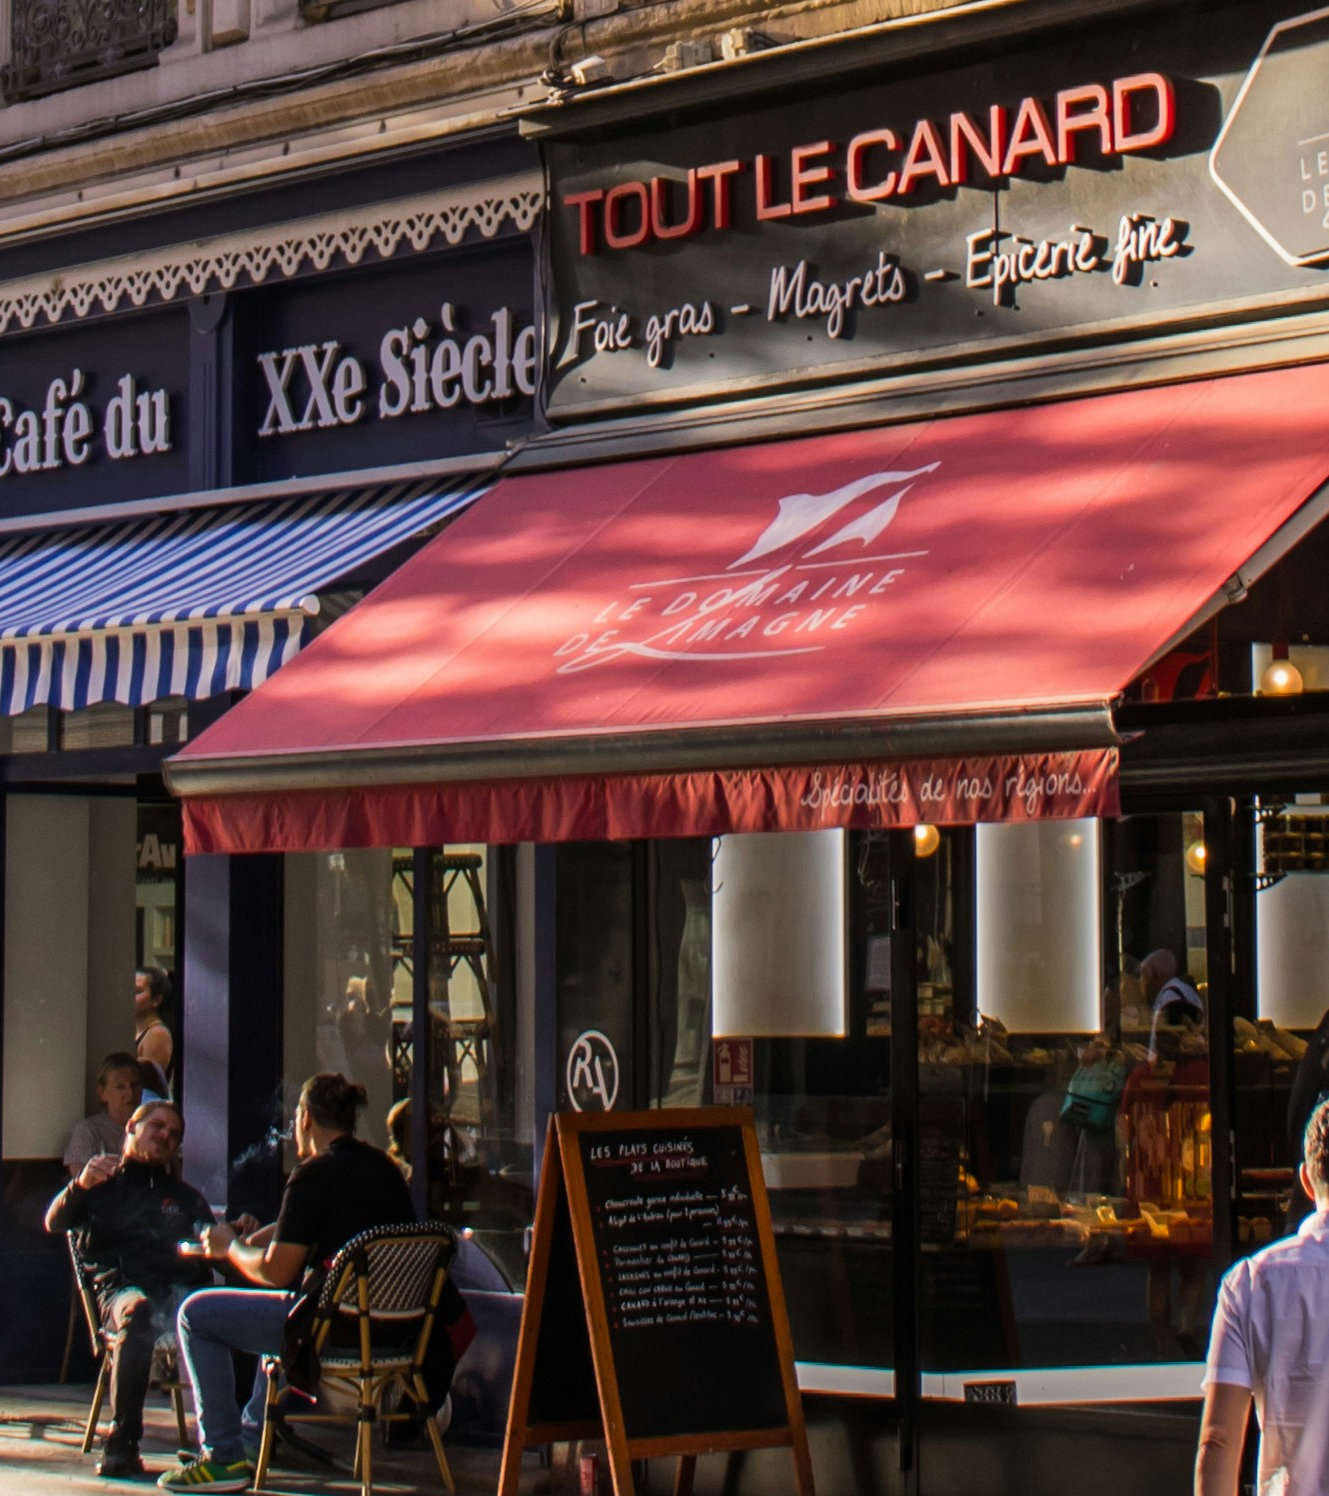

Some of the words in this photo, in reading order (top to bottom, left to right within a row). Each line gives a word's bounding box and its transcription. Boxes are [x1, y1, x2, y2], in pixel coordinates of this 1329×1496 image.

[563, 159, 744, 256] TOUT
[755, 140, 836, 221] LE
[847, 72, 1177, 202] CANARD
[1300, 150, 1329, 180] LE
[572, 299, 633, 359] Foie
[646, 300, 716, 368] gras
[767, 259, 907, 339] Magrets
[966, 225, 1099, 306] Epicerie
[1112, 212, 1181, 285] fine
[257, 340, 367, 437] XXe
[379, 302, 536, 419] Siècle
[103, 372, 173, 459] du
[592, 597, 652, 624] LE
[661, 568, 906, 617] DOMAINE
[553, 628, 620, 657] DE
[800, 769, 908, 822] Spécialités
[919, 771, 946, 803] de
[956, 774, 993, 800] nos
[590, 1145, 611, 1160] LES
[619, 1143, 647, 1157] PLATS
[650, 1160, 661, 1173] LA
[665, 1155, 709, 1170] BOUTIQUE
